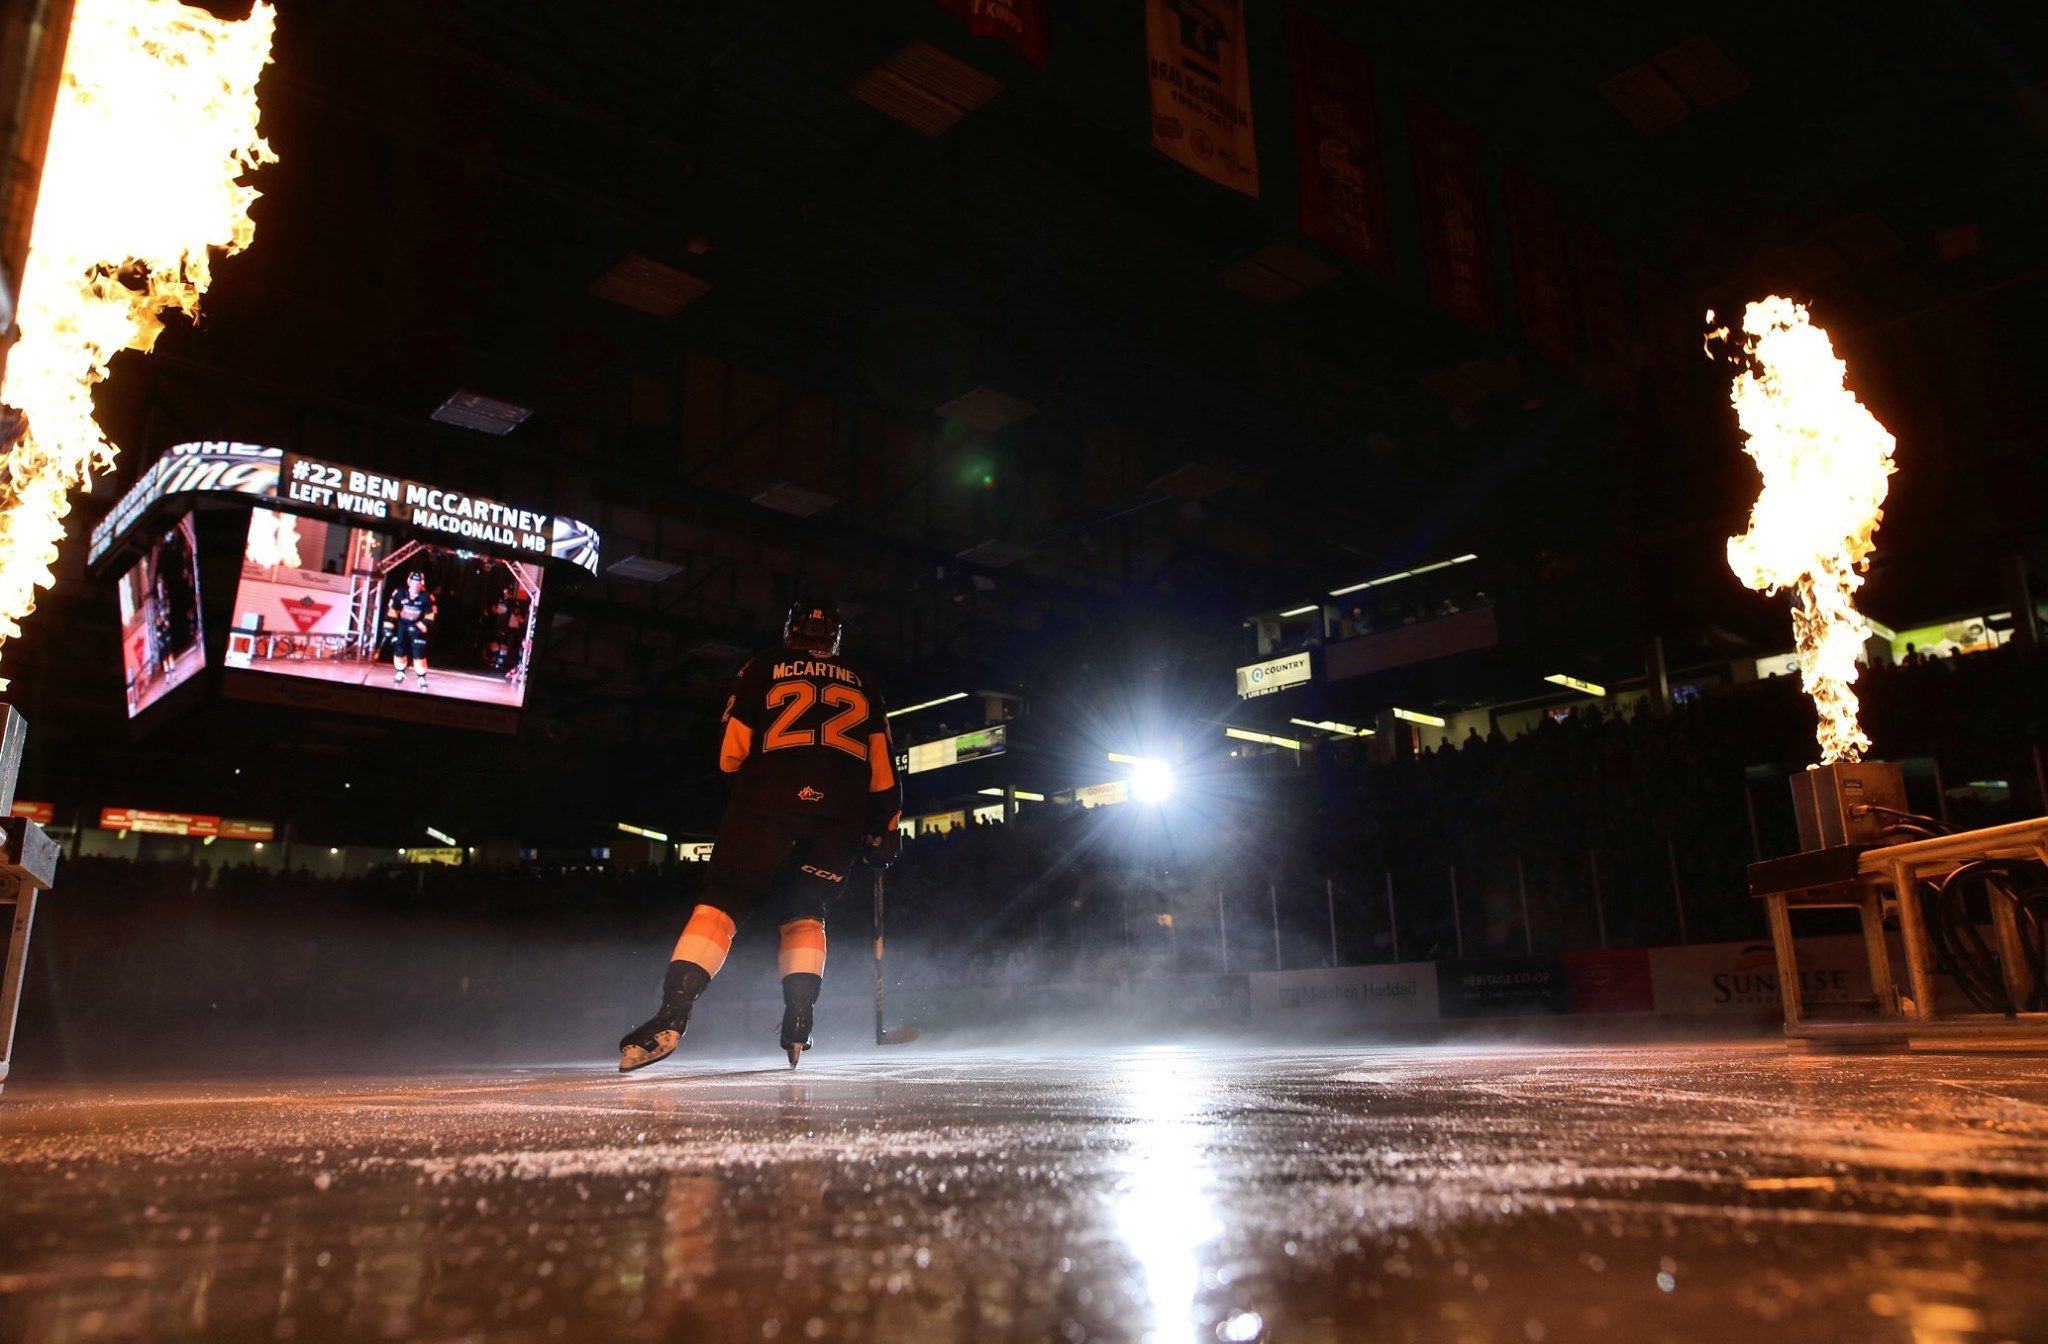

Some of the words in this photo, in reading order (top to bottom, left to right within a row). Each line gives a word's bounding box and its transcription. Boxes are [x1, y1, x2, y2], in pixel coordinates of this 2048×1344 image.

[290, 481, 333, 507] LEFT
[336, 491, 387, 519] WING
[291, 460, 343, 489] #22
[349, 470, 400, 501] BEN
[406, 484, 547, 533] MCCARTNEY
[412, 507, 517, 549] MACDONALD,
[522, 533, 546, 551] MB
[773, 660, 863, 687] McCARTNEY
[1265, 659, 1304, 675] COUNTRY
[762, 679, 870, 762] 22
[895, 754, 908, 765] EG
[801, 865, 844, 882] CCM
[1363, 980, 1416, 999] Haddad
[1462, 974, 1512, 987] HERITAGE
[1514, 971, 1551, 985] CO-OP
[1713, 969, 1846, 1003] SUNISE
